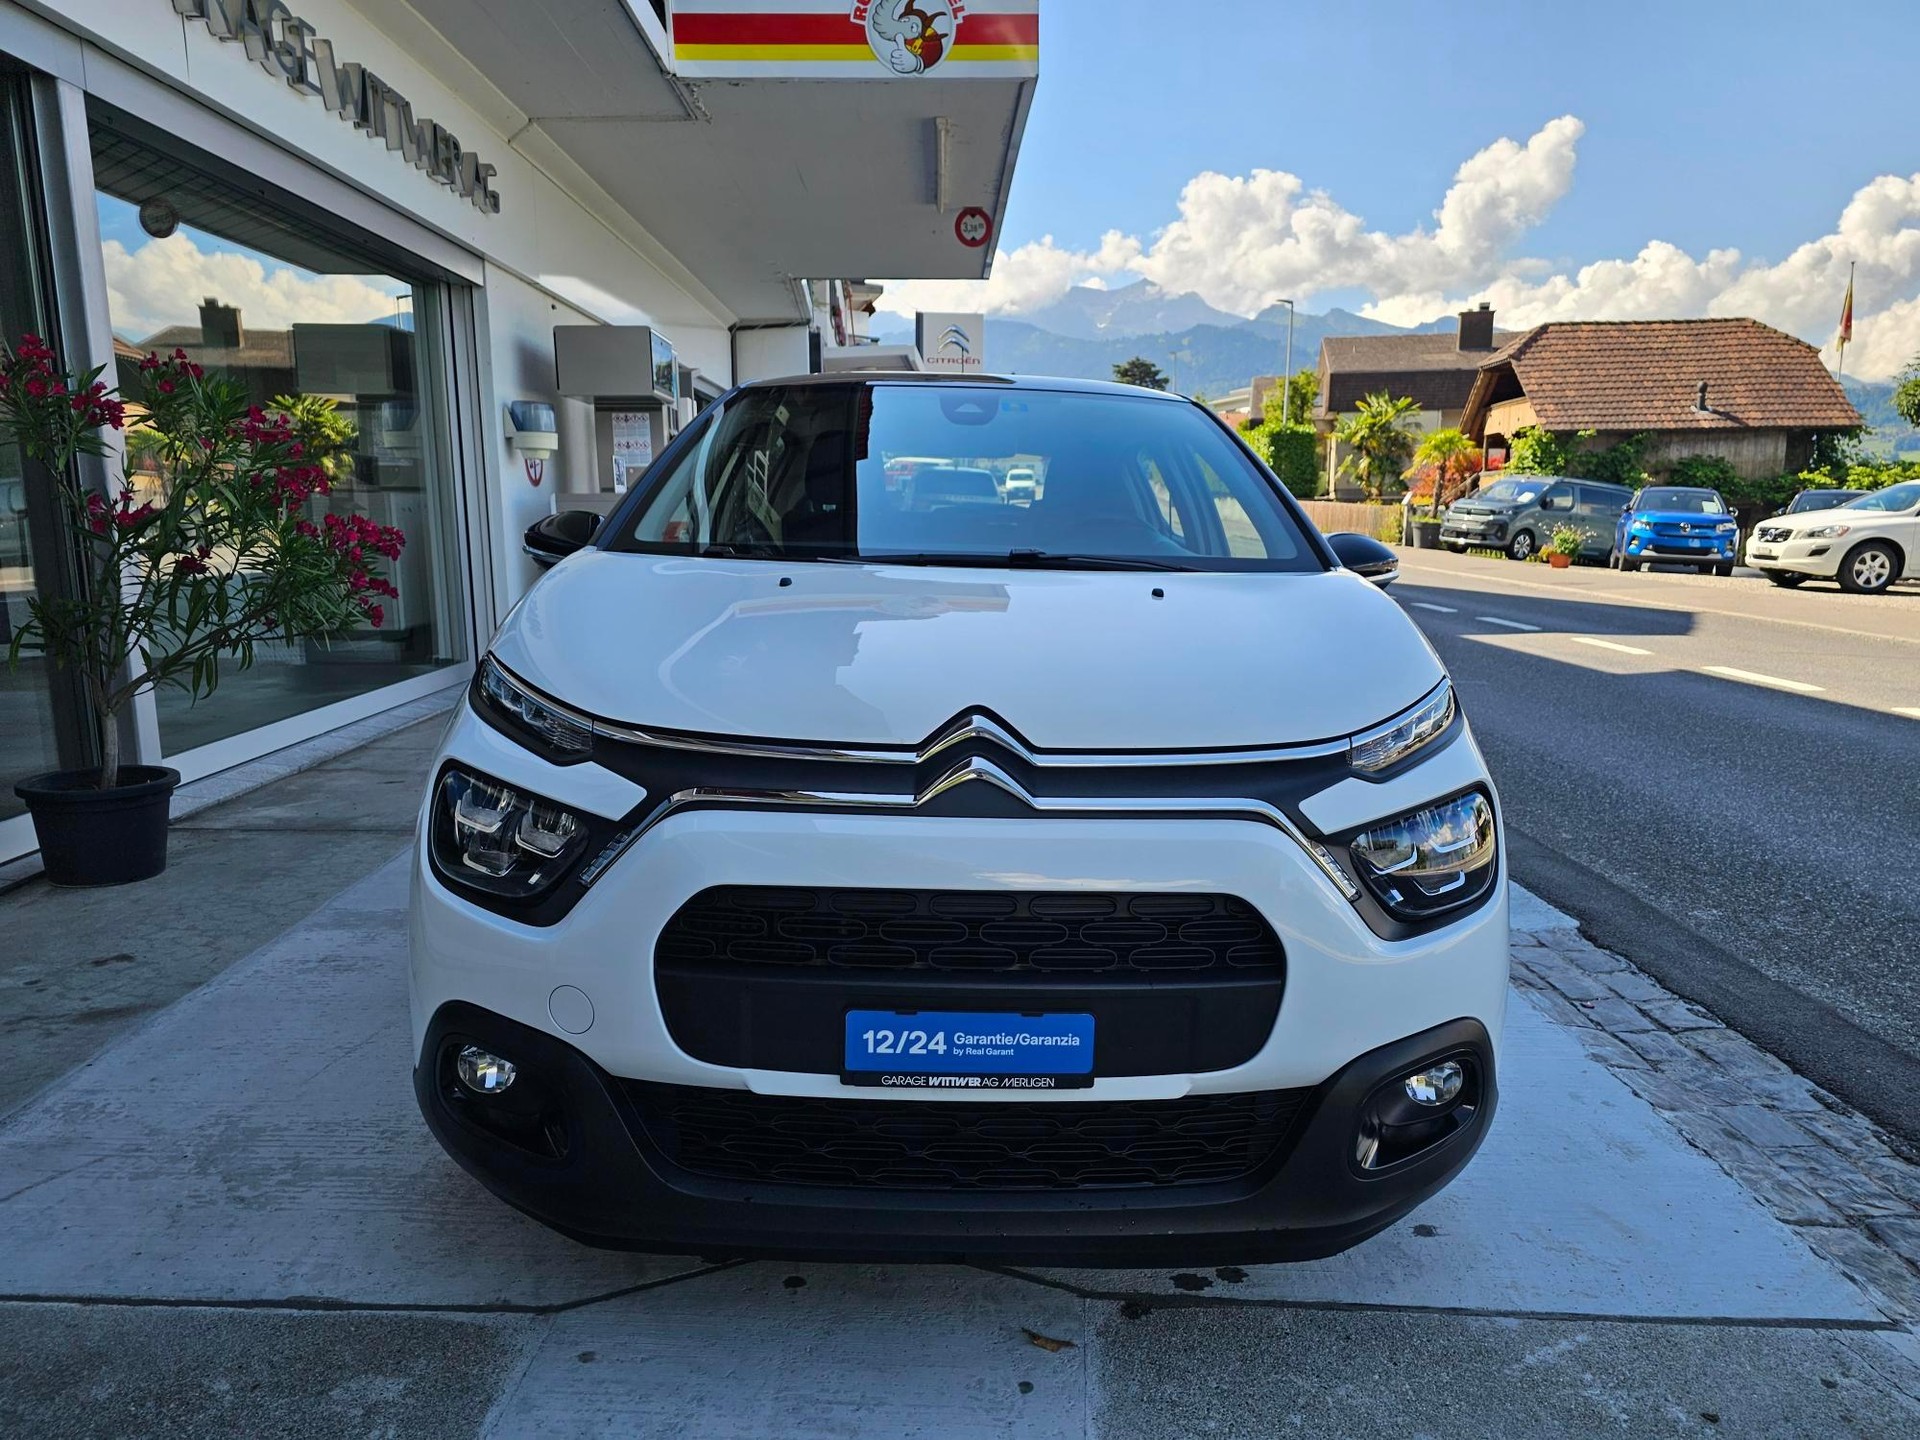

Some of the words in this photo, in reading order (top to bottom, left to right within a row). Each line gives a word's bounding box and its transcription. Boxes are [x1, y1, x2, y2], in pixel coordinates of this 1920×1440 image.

[862, 1029, 947, 1055] 12/24
[953, 1032, 1080, 1047] Garantie/Garanzia
[953, 1047, 964, 1057] by
[965, 1047, 984, 1056] Real
[985, 1047, 1014, 1056] Garant
[881, 1075, 927, 1086] GARAGE
[928, 1076, 981, 1087] WITTWER
[981, 1077, 999, 1087] AG
[1001, 1077, 1055, 1088] MERLIGEN
